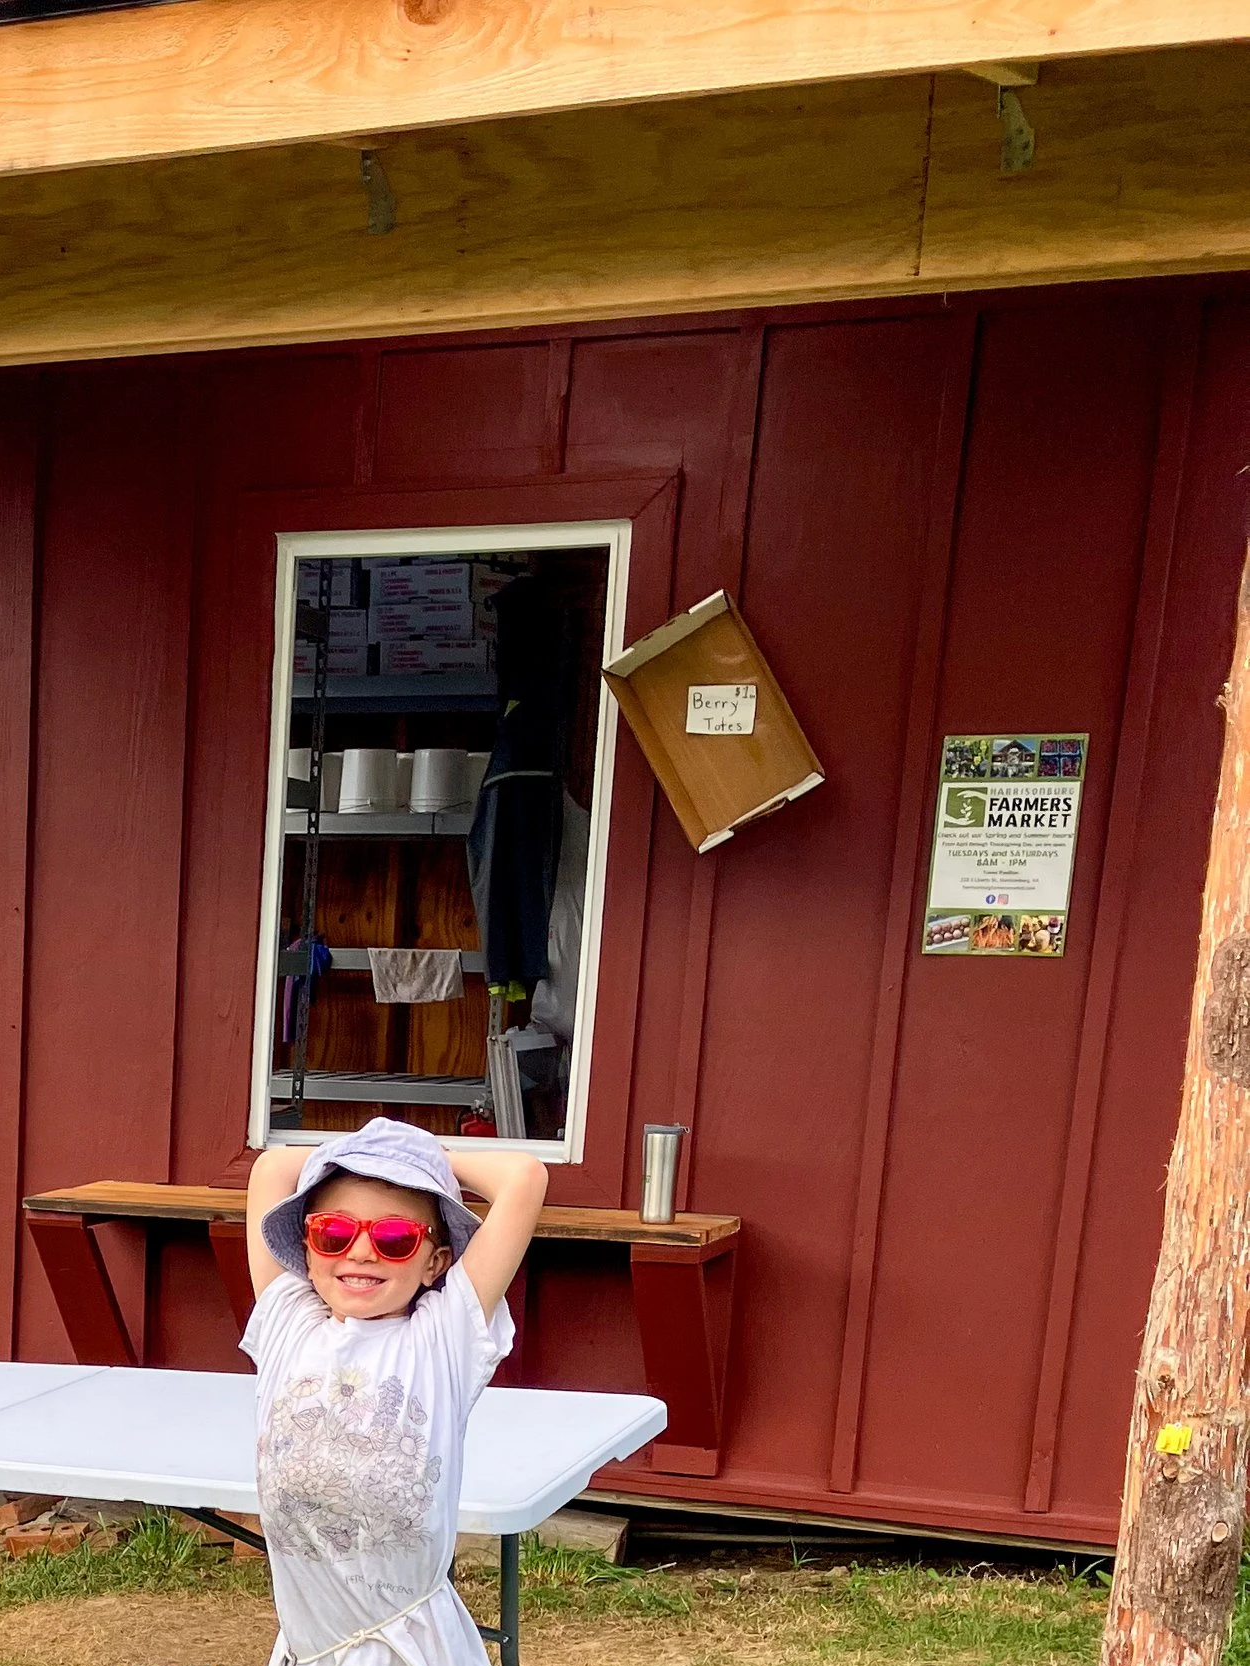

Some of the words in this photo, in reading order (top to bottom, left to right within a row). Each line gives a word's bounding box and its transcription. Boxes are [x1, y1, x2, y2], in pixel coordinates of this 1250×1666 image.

[693, 692, 738, 717] Berry
[703, 717, 743, 732] Totes
[990, 787, 1075, 796] HARRISONBURG
[989, 797, 1072, 812] FARMERS
[987, 813, 1072, 828] MARKET
[1010, 850, 1058, 858] SATURDAYS
[976, 858, 998, 867] 8AM
[1009, 859, 1027, 867] 1PM
